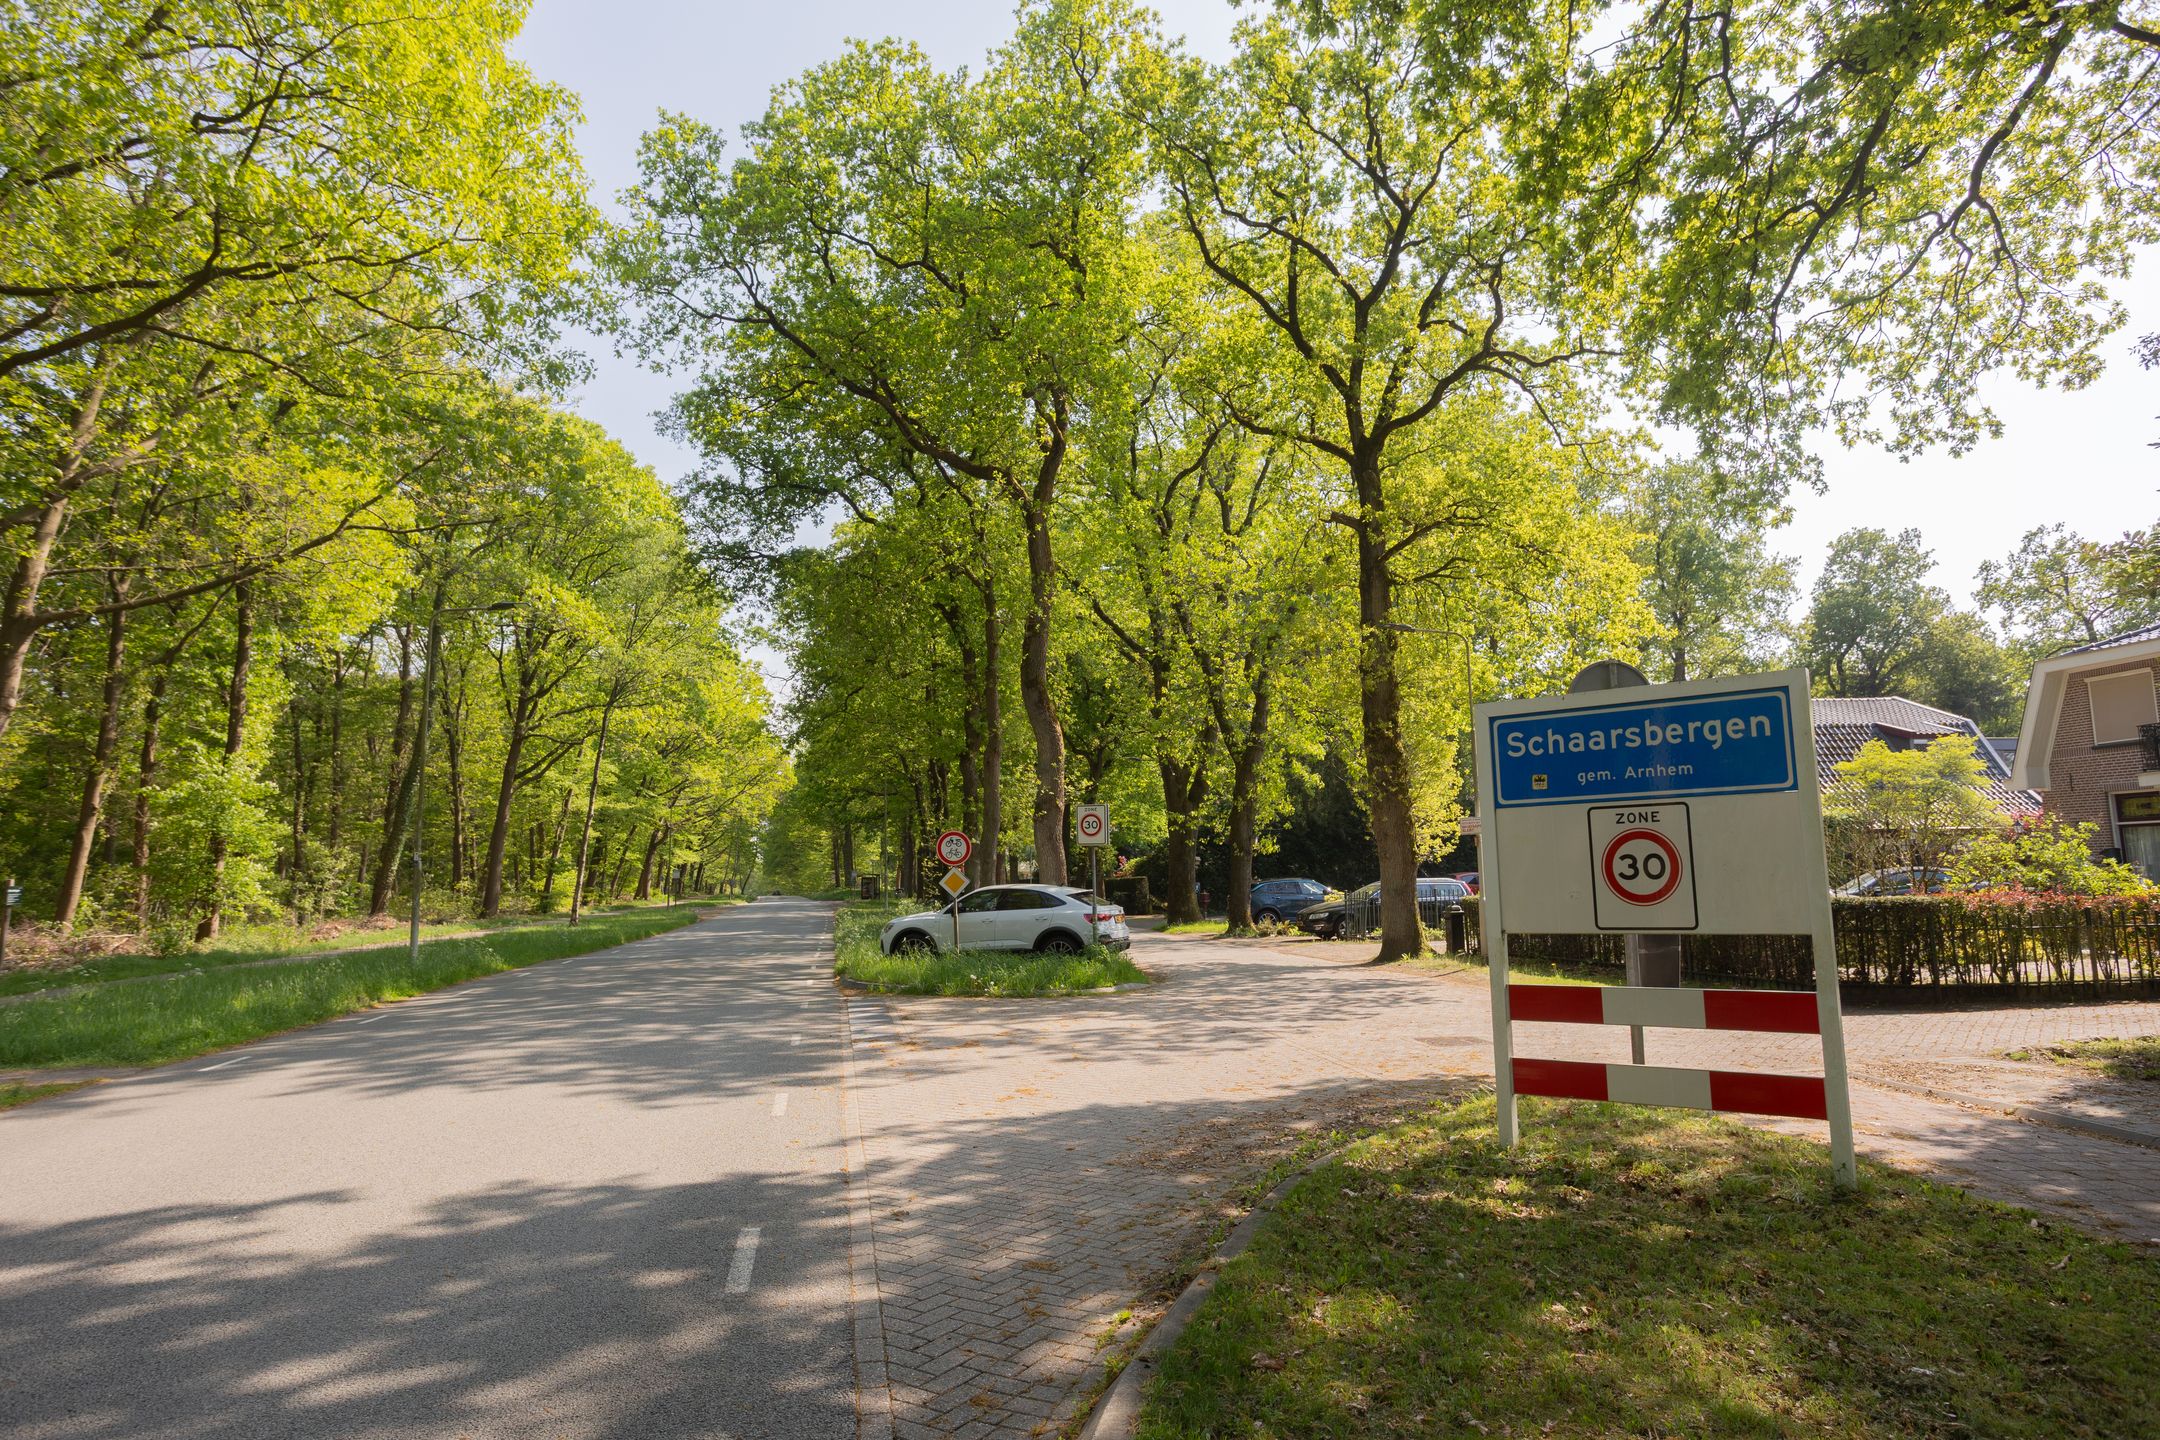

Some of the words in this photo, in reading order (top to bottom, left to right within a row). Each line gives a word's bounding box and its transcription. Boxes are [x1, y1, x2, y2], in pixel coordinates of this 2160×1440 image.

[1507, 715, 1771, 758] Schaarsbergen
[1577, 769, 1616, 786] gem.
[1624, 763, 1694, 780] Arnhem
[1084, 820, 1098, 829] 30
[1615, 811, 1660, 824] ZONE
[1618, 853, 1666, 880] 30
